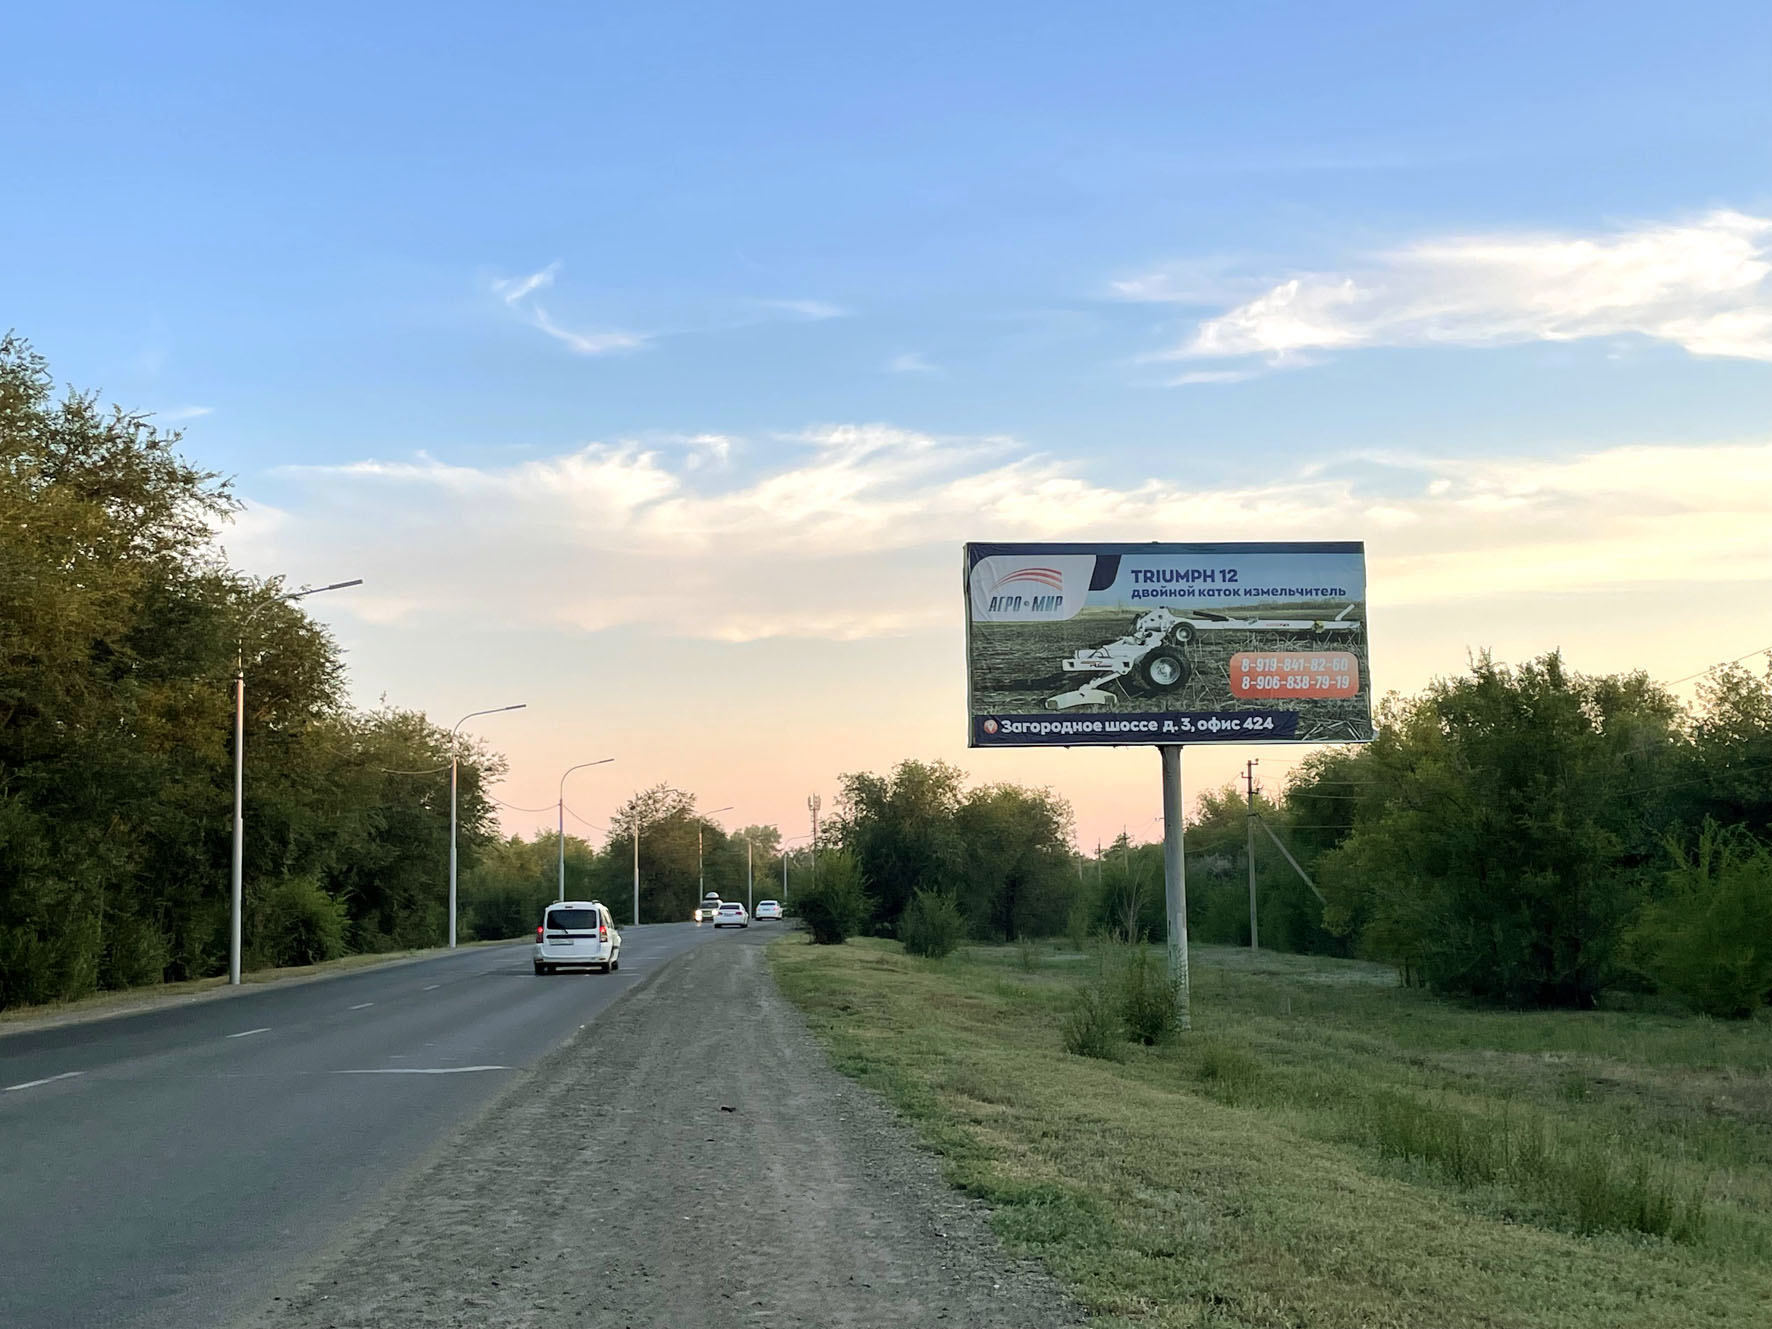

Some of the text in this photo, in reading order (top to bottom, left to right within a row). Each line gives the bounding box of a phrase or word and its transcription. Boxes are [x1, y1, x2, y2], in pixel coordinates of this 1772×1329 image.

[1131, 569, 1238, 583] TRIUMPH 12
[1131, 585, 1346, 599] двойной каток измельчитель
[988, 595, 1063, 612] АГРО МИР
[1242, 676, 1349, 689] 8-906-838-79-19
[1000, 717, 1273, 735] Загородное шоссе д. 3, офис 424
